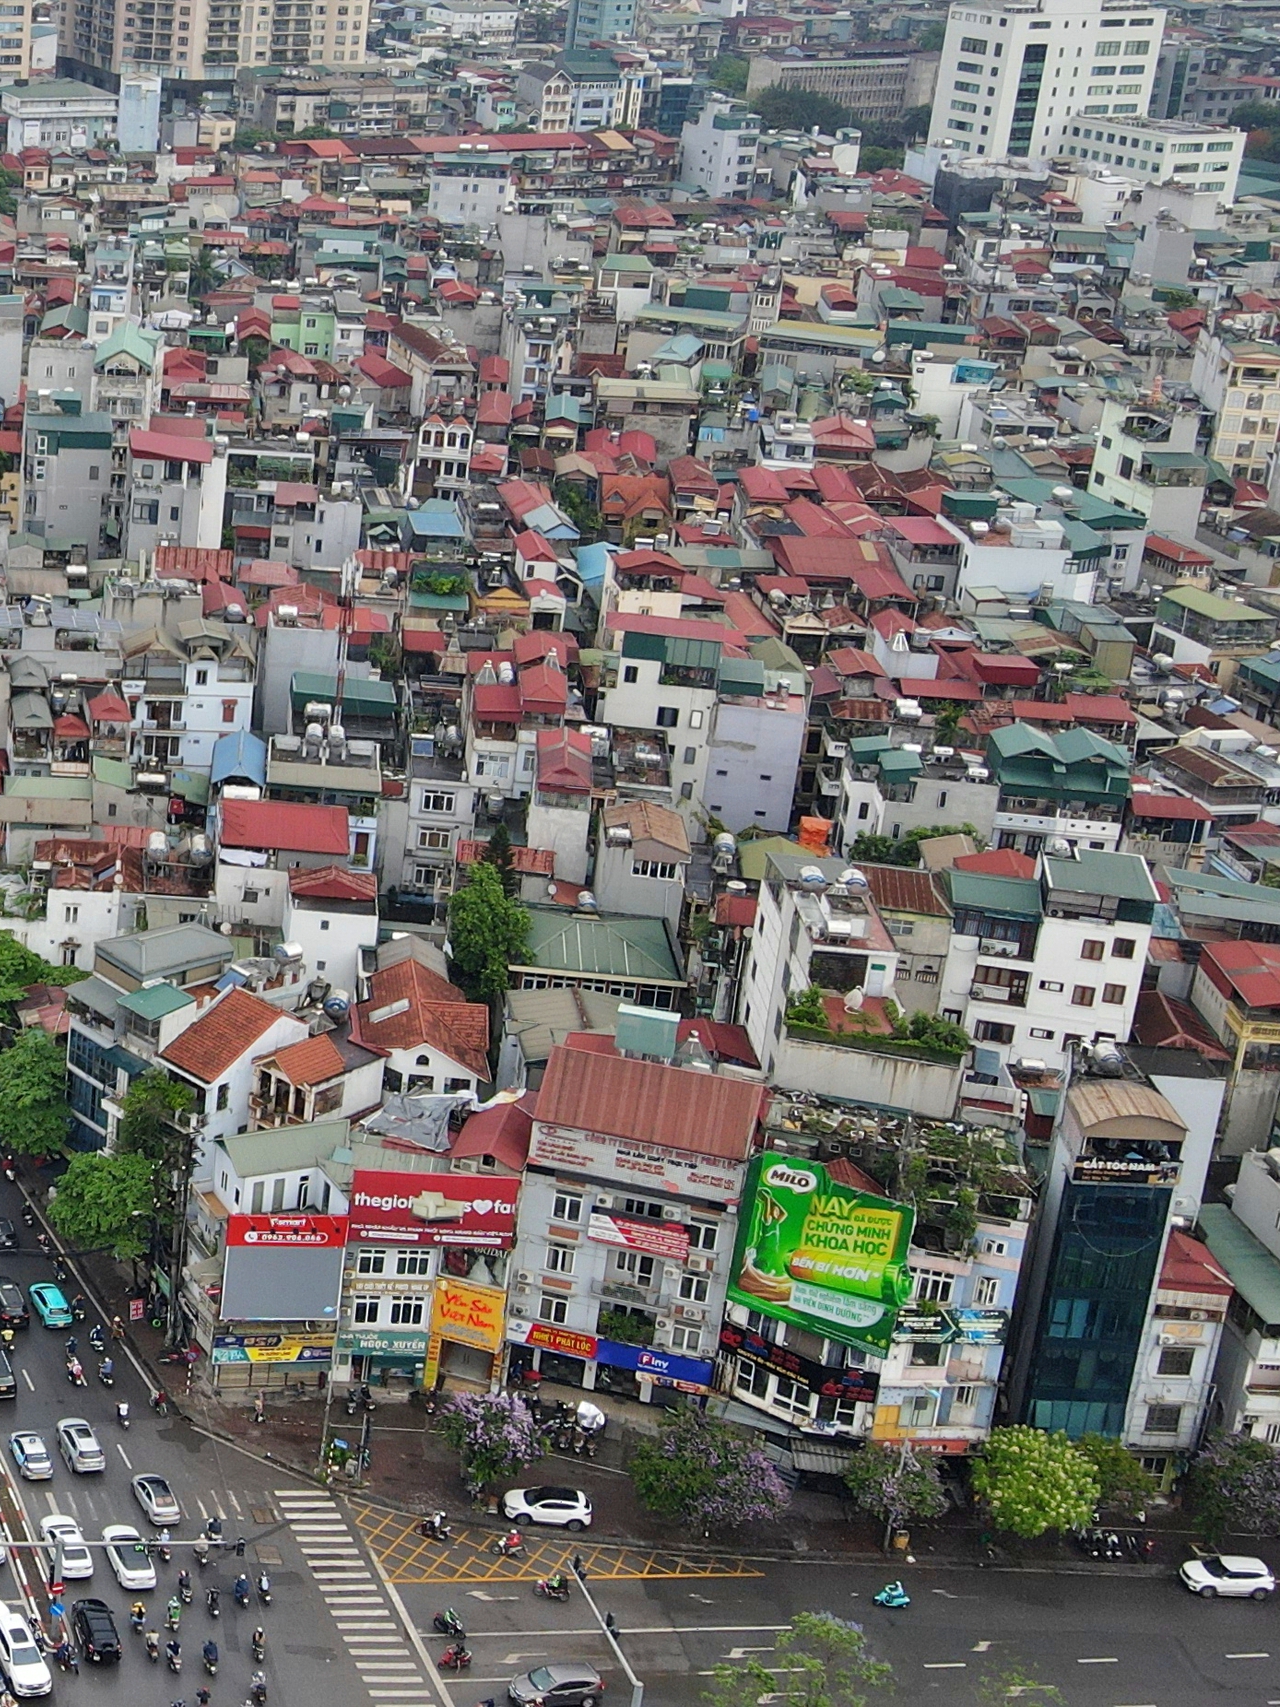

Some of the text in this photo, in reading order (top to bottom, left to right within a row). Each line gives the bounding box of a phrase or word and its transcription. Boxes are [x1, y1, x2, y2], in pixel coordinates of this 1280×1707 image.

[1083, 1157, 1155, 1171] CẮT TÓC NAM
[770, 1170, 810, 1188] MILO
[811, 1195, 858, 1219] NAY
[807, 1218, 891, 1240] CHỨNG MINH
[804, 1233, 888, 1257] KHOA HỌC
[360, 1340, 389, 1350] NGỌC
[392, 1338, 426, 1349] XUYẾN
